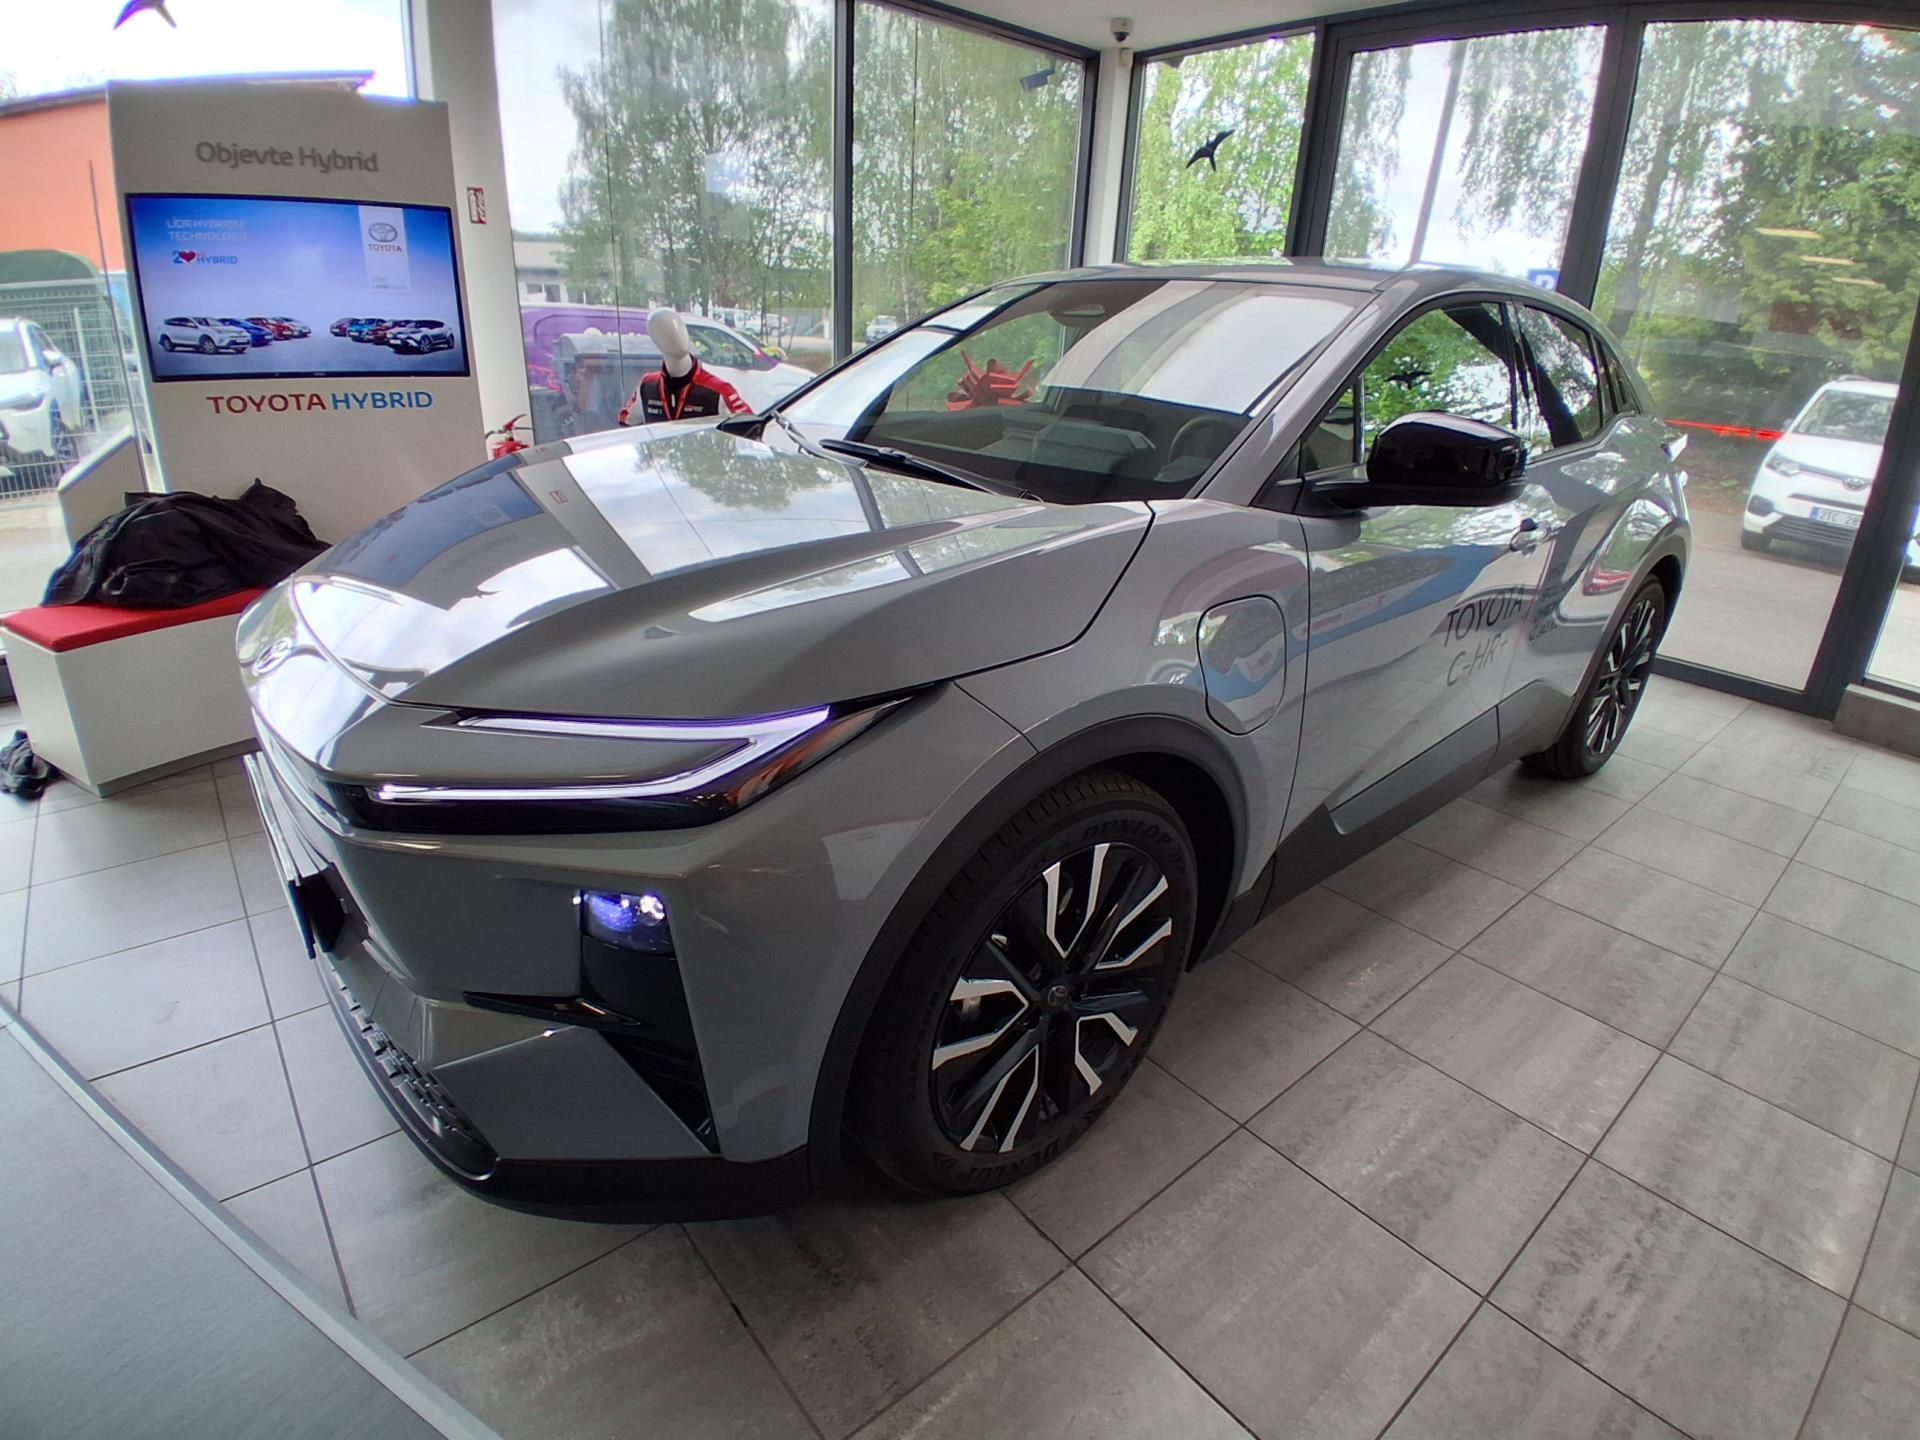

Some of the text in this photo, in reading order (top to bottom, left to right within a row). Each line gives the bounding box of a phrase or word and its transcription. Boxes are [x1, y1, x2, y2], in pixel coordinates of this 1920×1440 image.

[196, 141, 379, 173] Objevte Hybrid
[197, 255, 239, 265] HYBRID
[368, 243, 403, 252] TOYOTA
[206, 391, 433, 414] TOYOTA HYBRID
[1444, 585, 1524, 648] TOYOTA
[1080, 818, 1174, 845] DUNLOP
